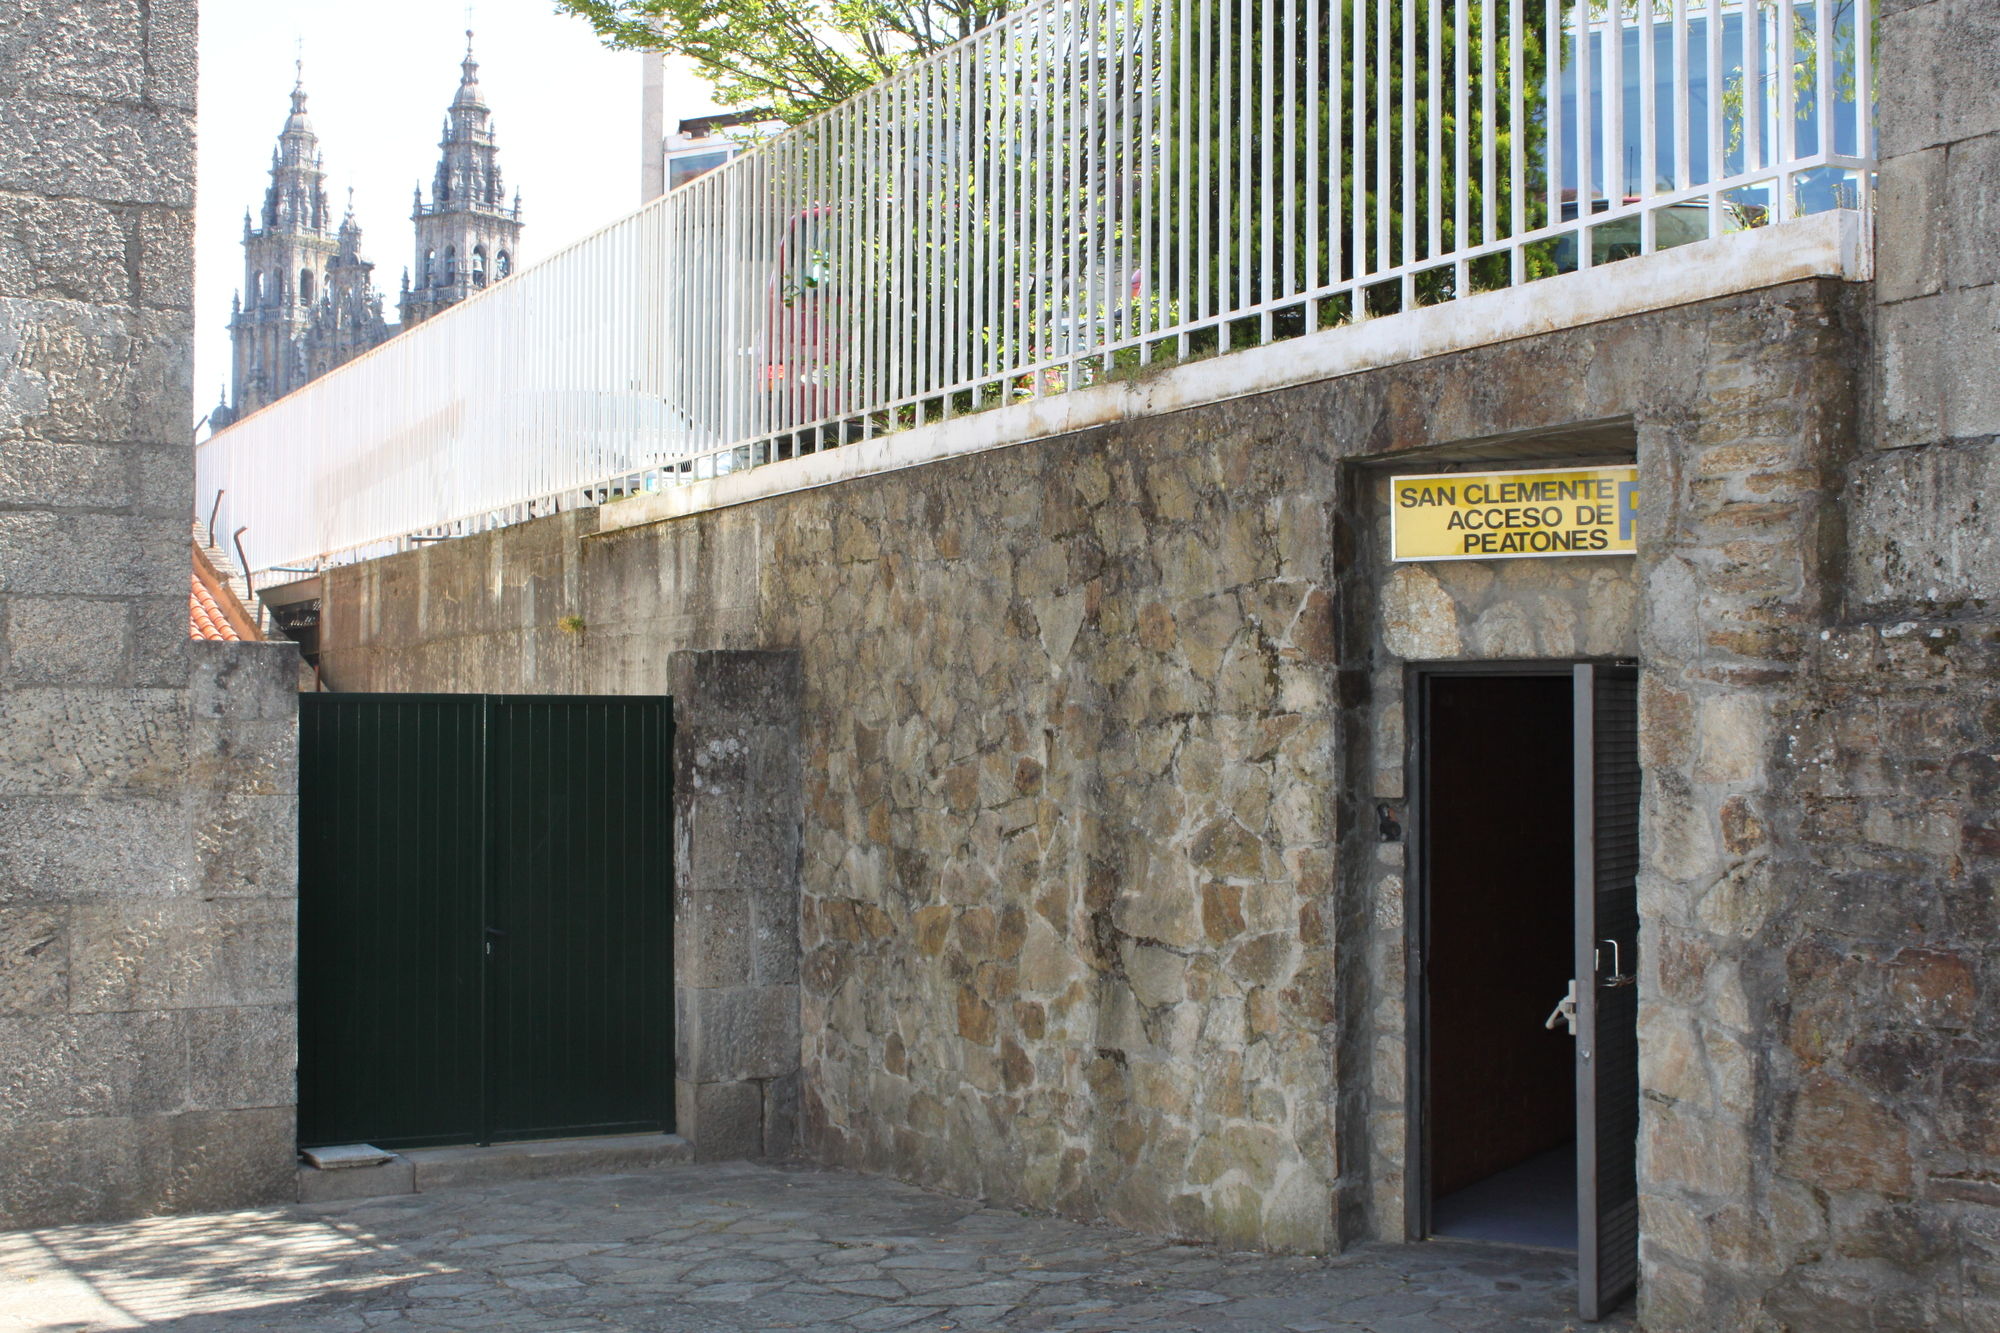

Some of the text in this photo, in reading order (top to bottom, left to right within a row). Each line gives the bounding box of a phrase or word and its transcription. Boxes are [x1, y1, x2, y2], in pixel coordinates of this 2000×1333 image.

[1400, 479, 1614, 508] SAN CLEMENTE
[1447, 505, 1614, 530] ACCESO DE
[1464, 529, 1609, 553] PEATONES
